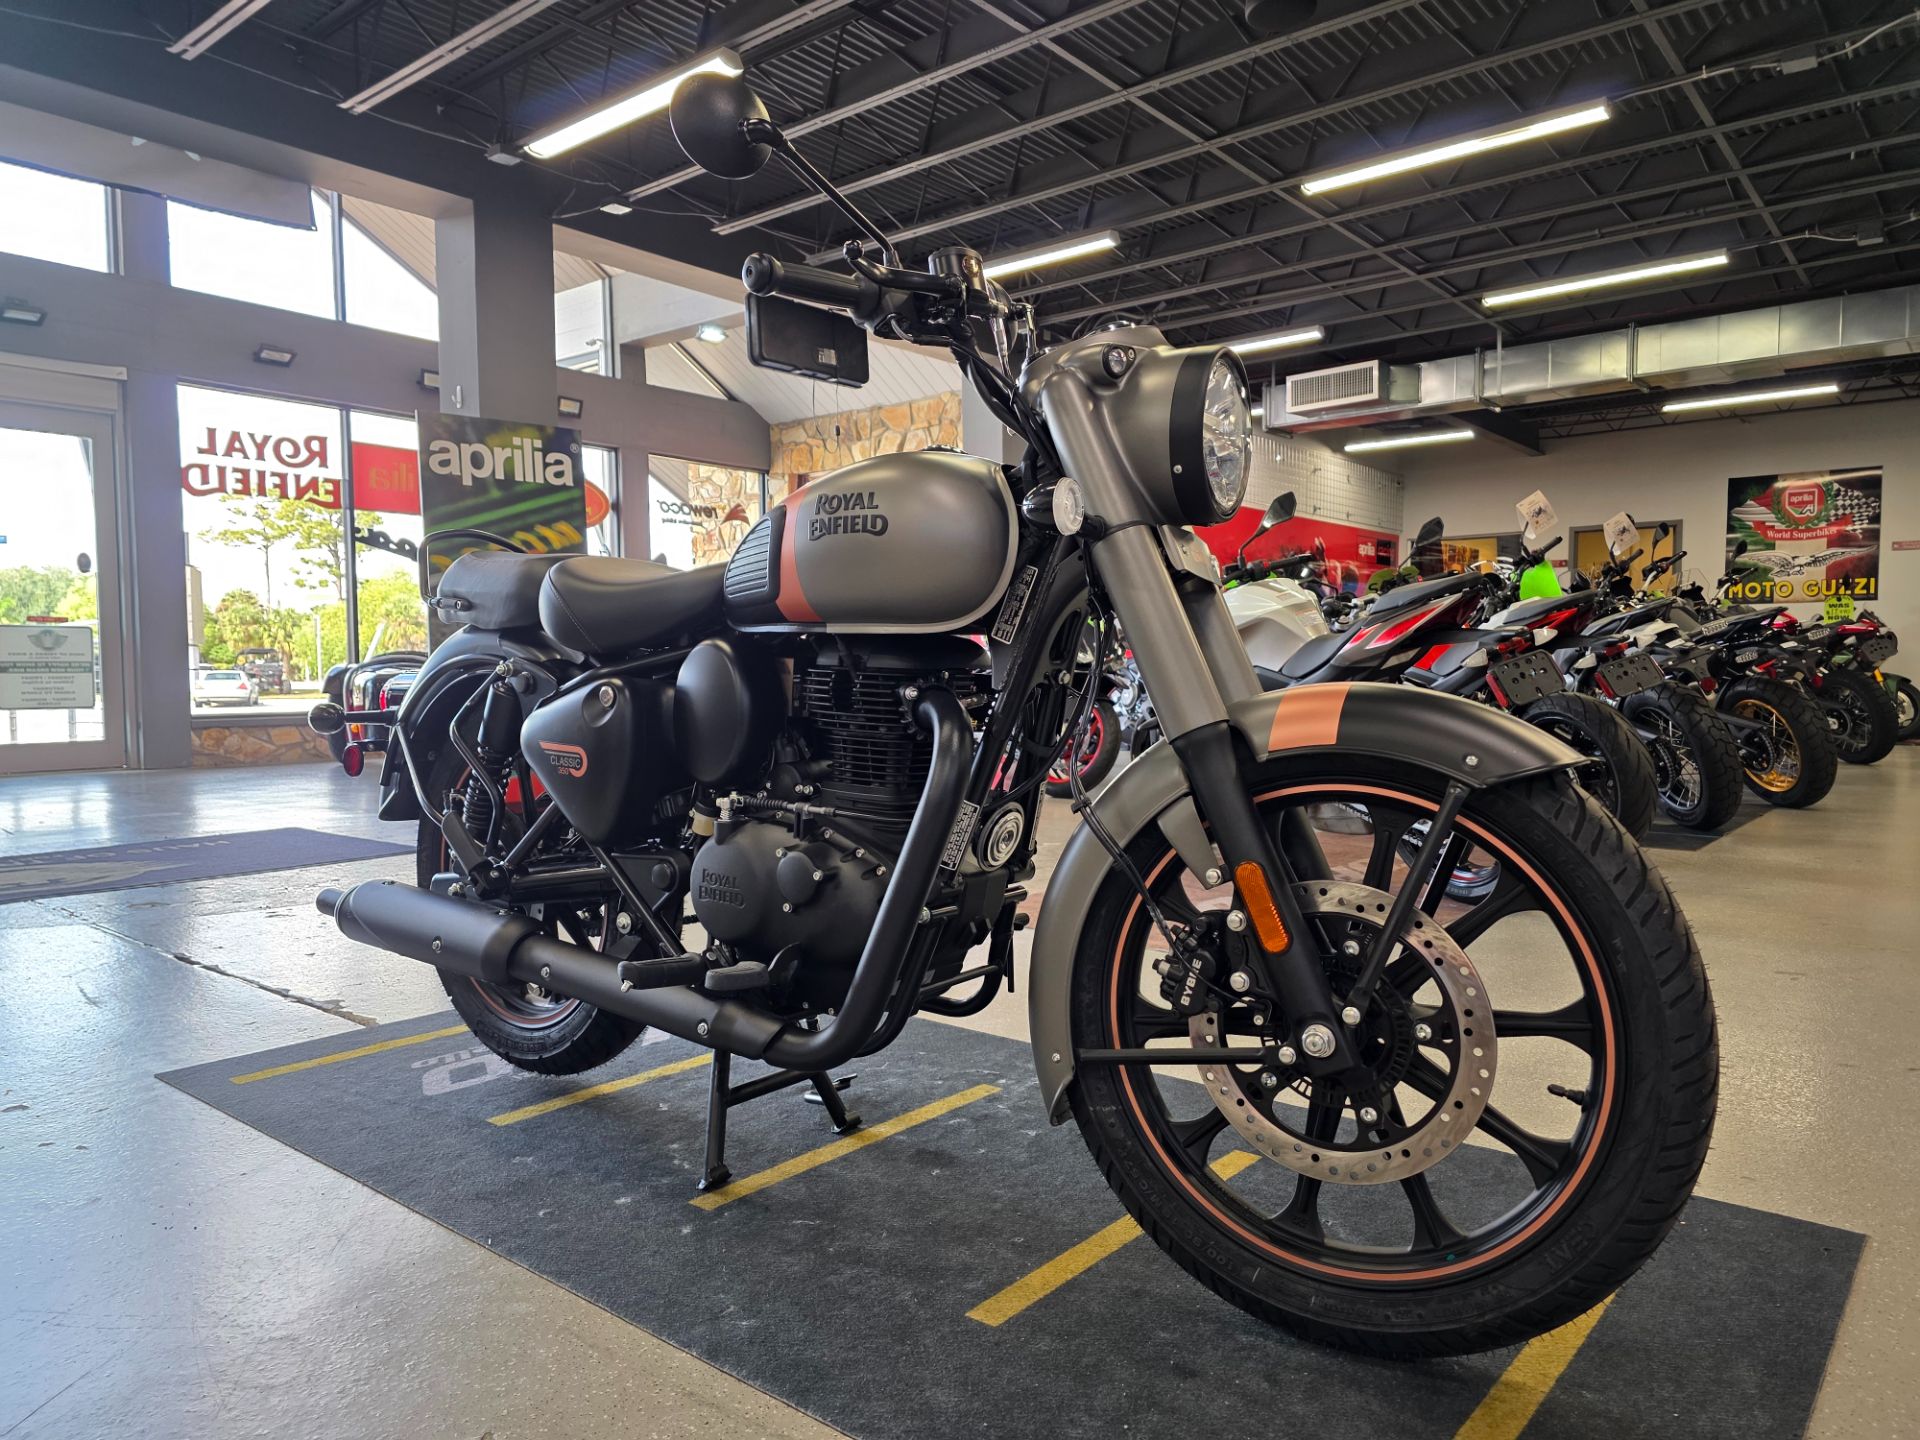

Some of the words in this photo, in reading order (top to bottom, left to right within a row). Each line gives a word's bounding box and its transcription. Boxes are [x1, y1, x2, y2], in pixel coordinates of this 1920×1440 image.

[429, 436, 574, 487] aprilia
[815, 491, 878, 515] ROYAL
[1790, 493, 1813, 504] aprilia
[808, 514, 889, 542] ENFIELD
[1766, 529, 1791, 539] World
[1793, 527, 1838, 541] Superbikes
[1728, 580, 1794, 599] MOTO
[550, 755, 581, 769] CLASSIC
[702, 868, 740, 889] ROYAL
